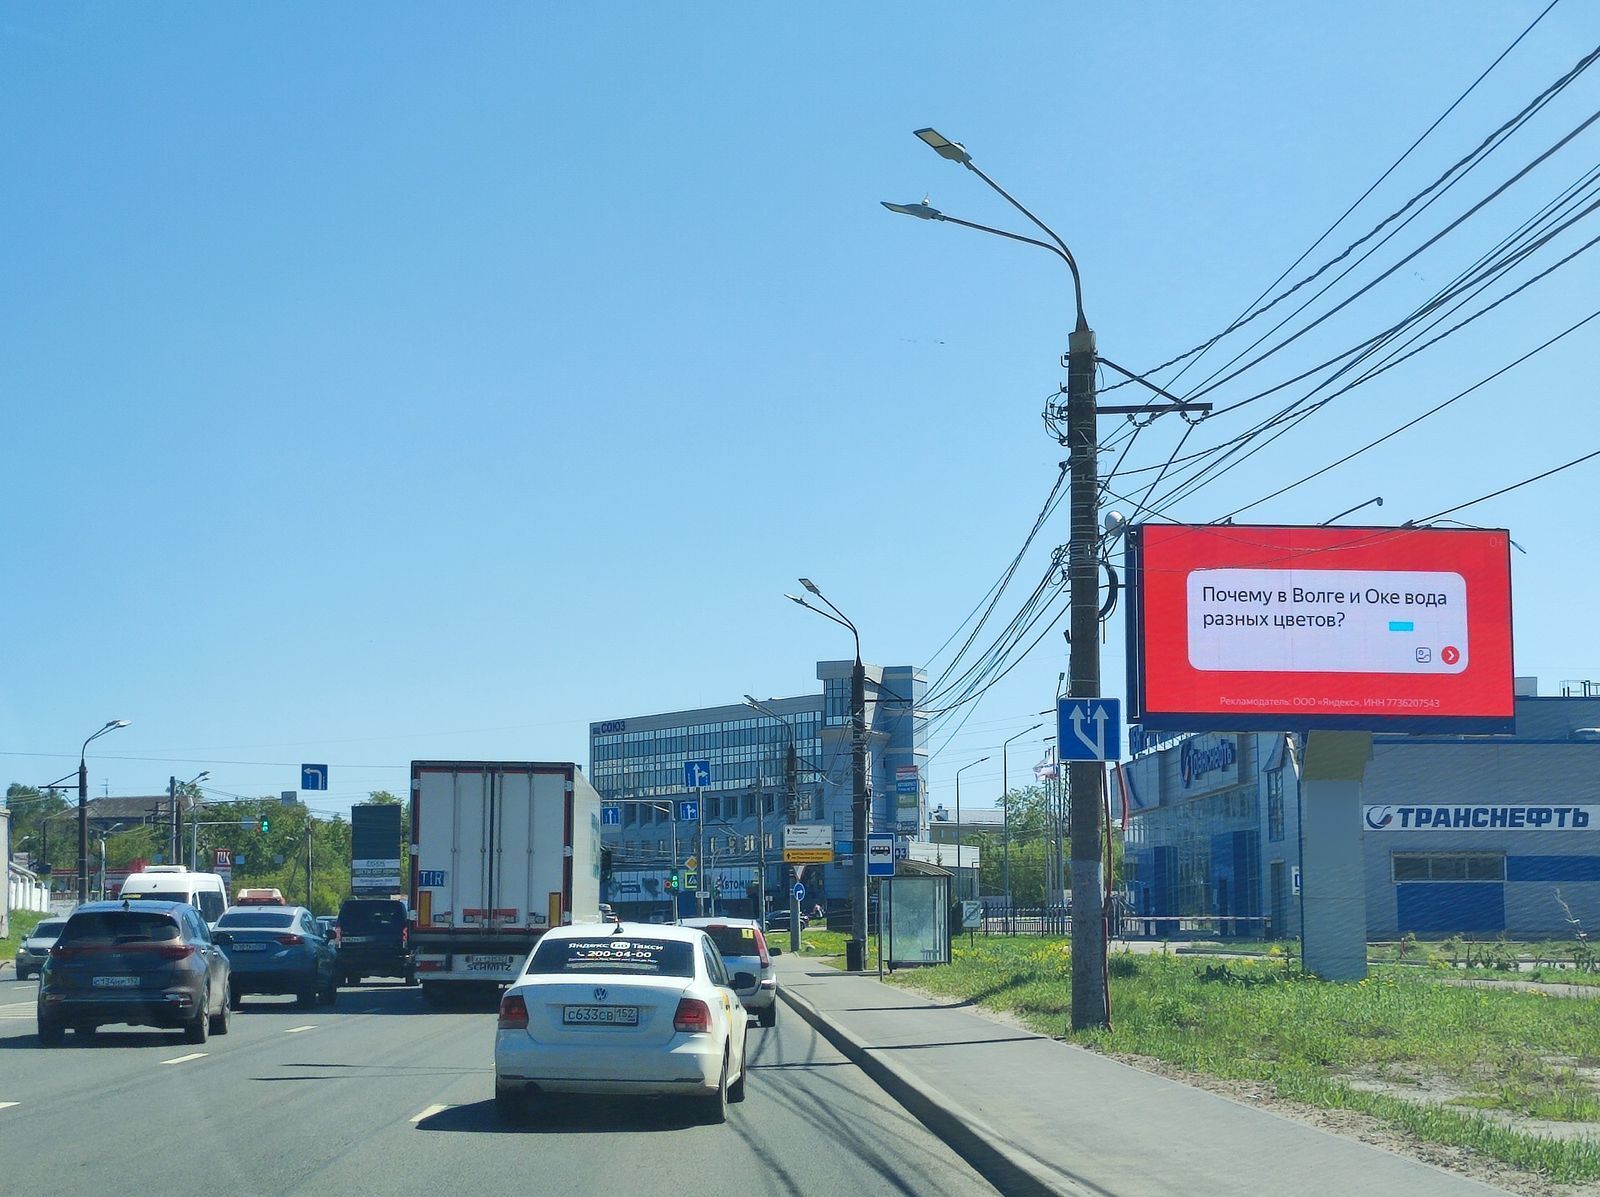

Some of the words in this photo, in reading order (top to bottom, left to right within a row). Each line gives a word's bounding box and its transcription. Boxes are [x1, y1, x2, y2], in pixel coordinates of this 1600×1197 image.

[1202, 586, 1273, 606] Почему
[1278, 590, 1288, 603] в
[1292, 587, 1345, 604] Волге
[1350, 591, 1361, 604] и
[1365, 588, 1401, 604] Оке
[1405, 592, 1448, 608] вода
[1202, 613, 1270, 629] разных
[1273, 611, 1346, 630] цветов?
[1219, 696, 1292, 707] Рекламодатель:
[1292, 697, 1316, 706] ООО
[1363, 698, 1385, 707] ИНН
[1386, 698, 1441, 708] 7736207543
[601, 720, 626, 733] СОЮЗ
[1396, 807, 1590, 829] ТРАНСНЕФТЬ
[420, 871, 442, 886] TIR
[568, 942, 609, 950] Яндекс
[632, 943, 664, 951] Такси
[587, 950, 652, 958] 200-04-00
[615, 1008, 634, 1019] 152
